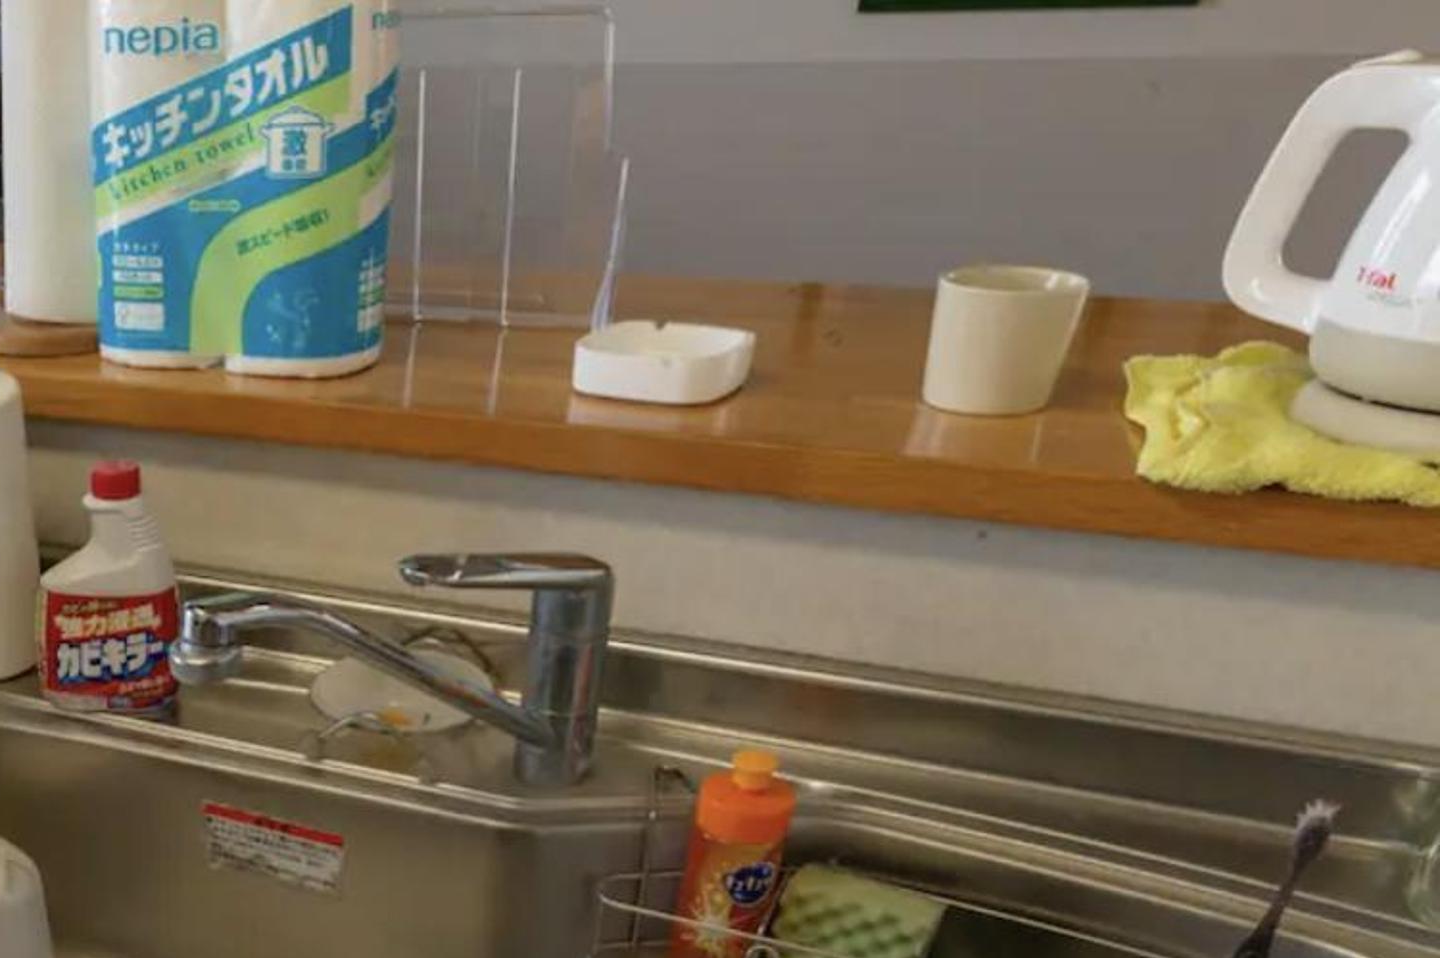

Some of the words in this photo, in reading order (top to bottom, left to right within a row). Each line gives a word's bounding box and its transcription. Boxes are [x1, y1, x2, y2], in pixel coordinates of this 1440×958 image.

[104, 17, 220, 56] nepia
[102, 36, 329, 168] キッチンタオル
[57, 631, 164, 679] カビキラー
